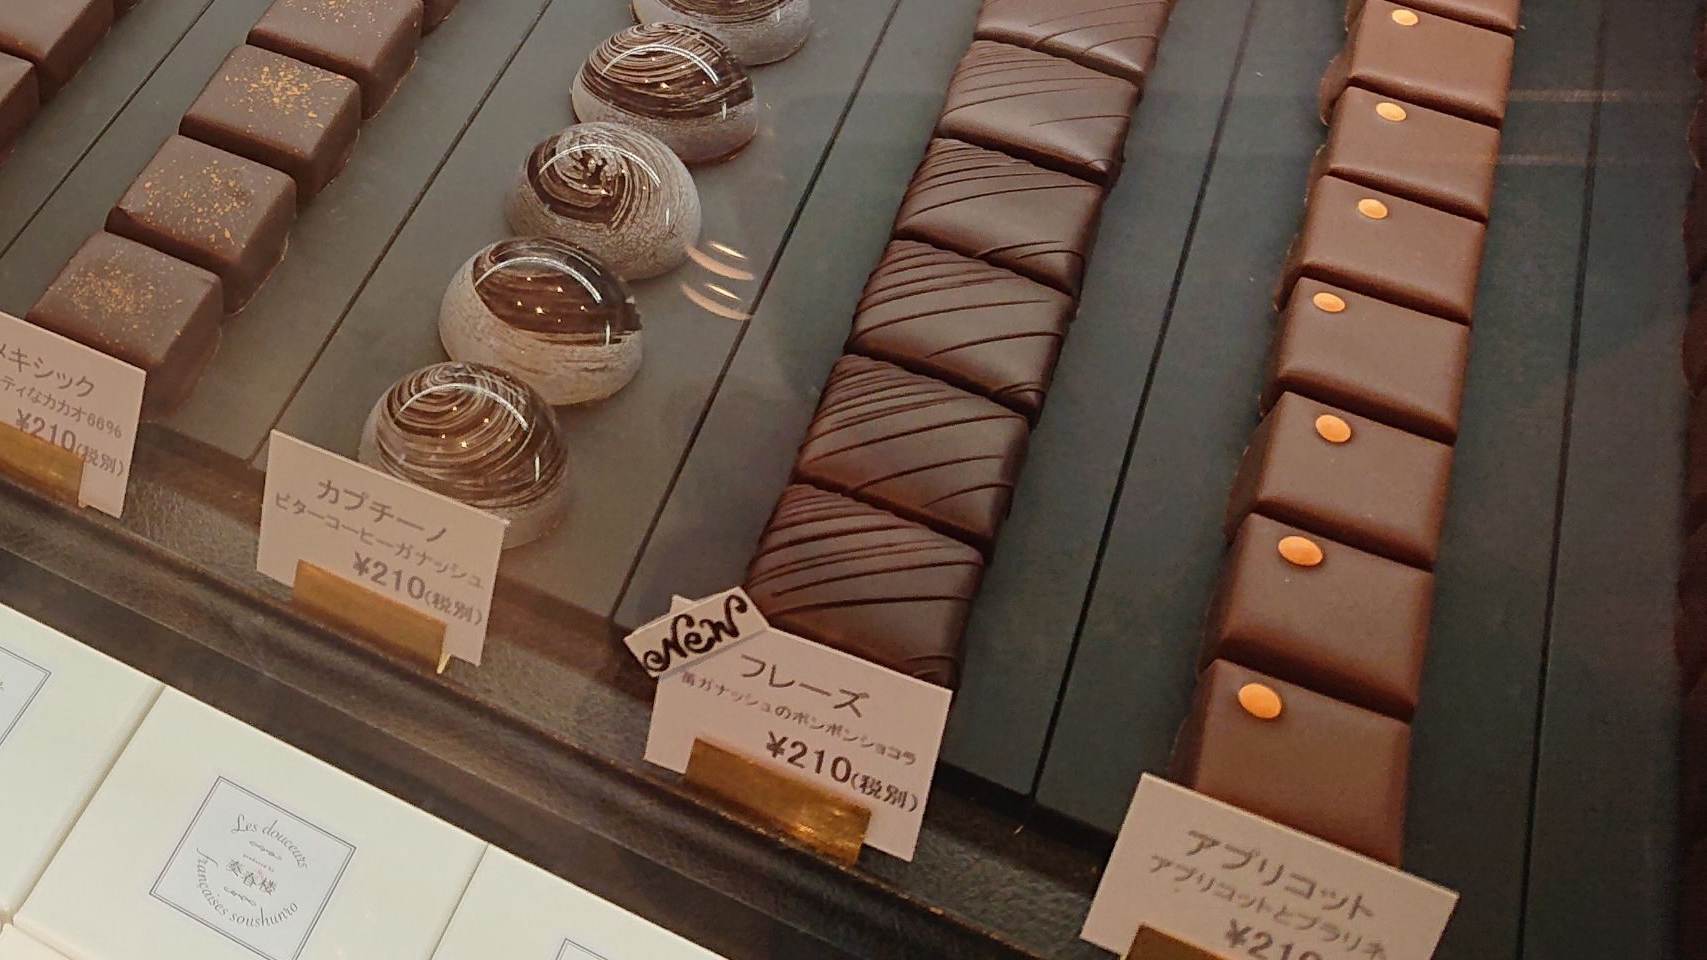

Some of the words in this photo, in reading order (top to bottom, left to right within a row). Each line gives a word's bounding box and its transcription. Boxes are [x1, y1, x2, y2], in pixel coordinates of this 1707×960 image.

[276, 492, 484, 590] ビターコーヒーガナッシュ
[317, 480, 446, 542] カプチーノ
[353, 551, 483, 625] ¥210(税別)
[741, 654, 870, 718] フレーズ
[766, 731, 918, 812] ¥210(税別)
[231, 814, 258, 834] Les
[262, 819, 308, 870] douceurs
[1187, 830, 1374, 920] アプリコット
[196, 848, 228, 917] françaises
[229, 901, 298, 927] soushunro
